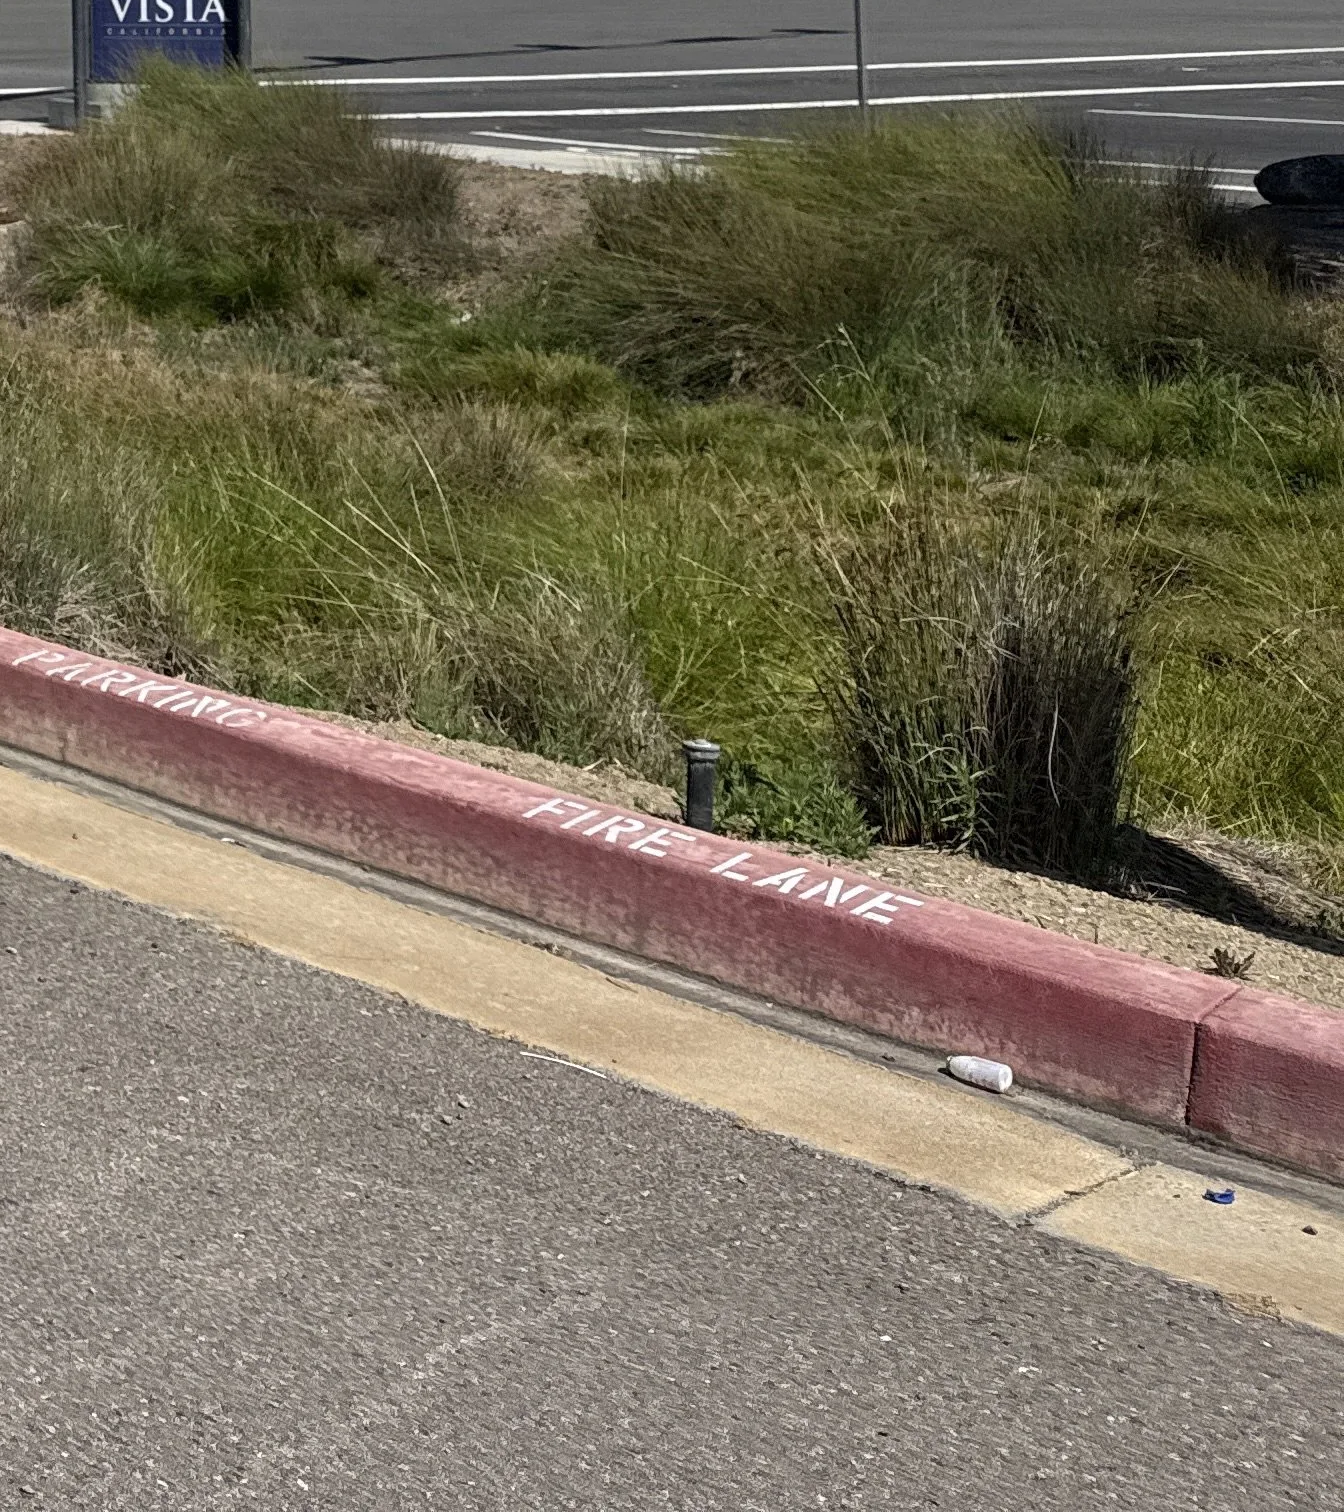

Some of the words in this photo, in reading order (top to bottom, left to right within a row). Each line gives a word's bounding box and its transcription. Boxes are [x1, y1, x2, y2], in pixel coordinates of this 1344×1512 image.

[107, 28, 227, 36] CALIFORNIA
[12, 649, 267, 728] PARKING
[522, 797, 697, 858] FIRE
[709, 852, 925, 925] LANE
